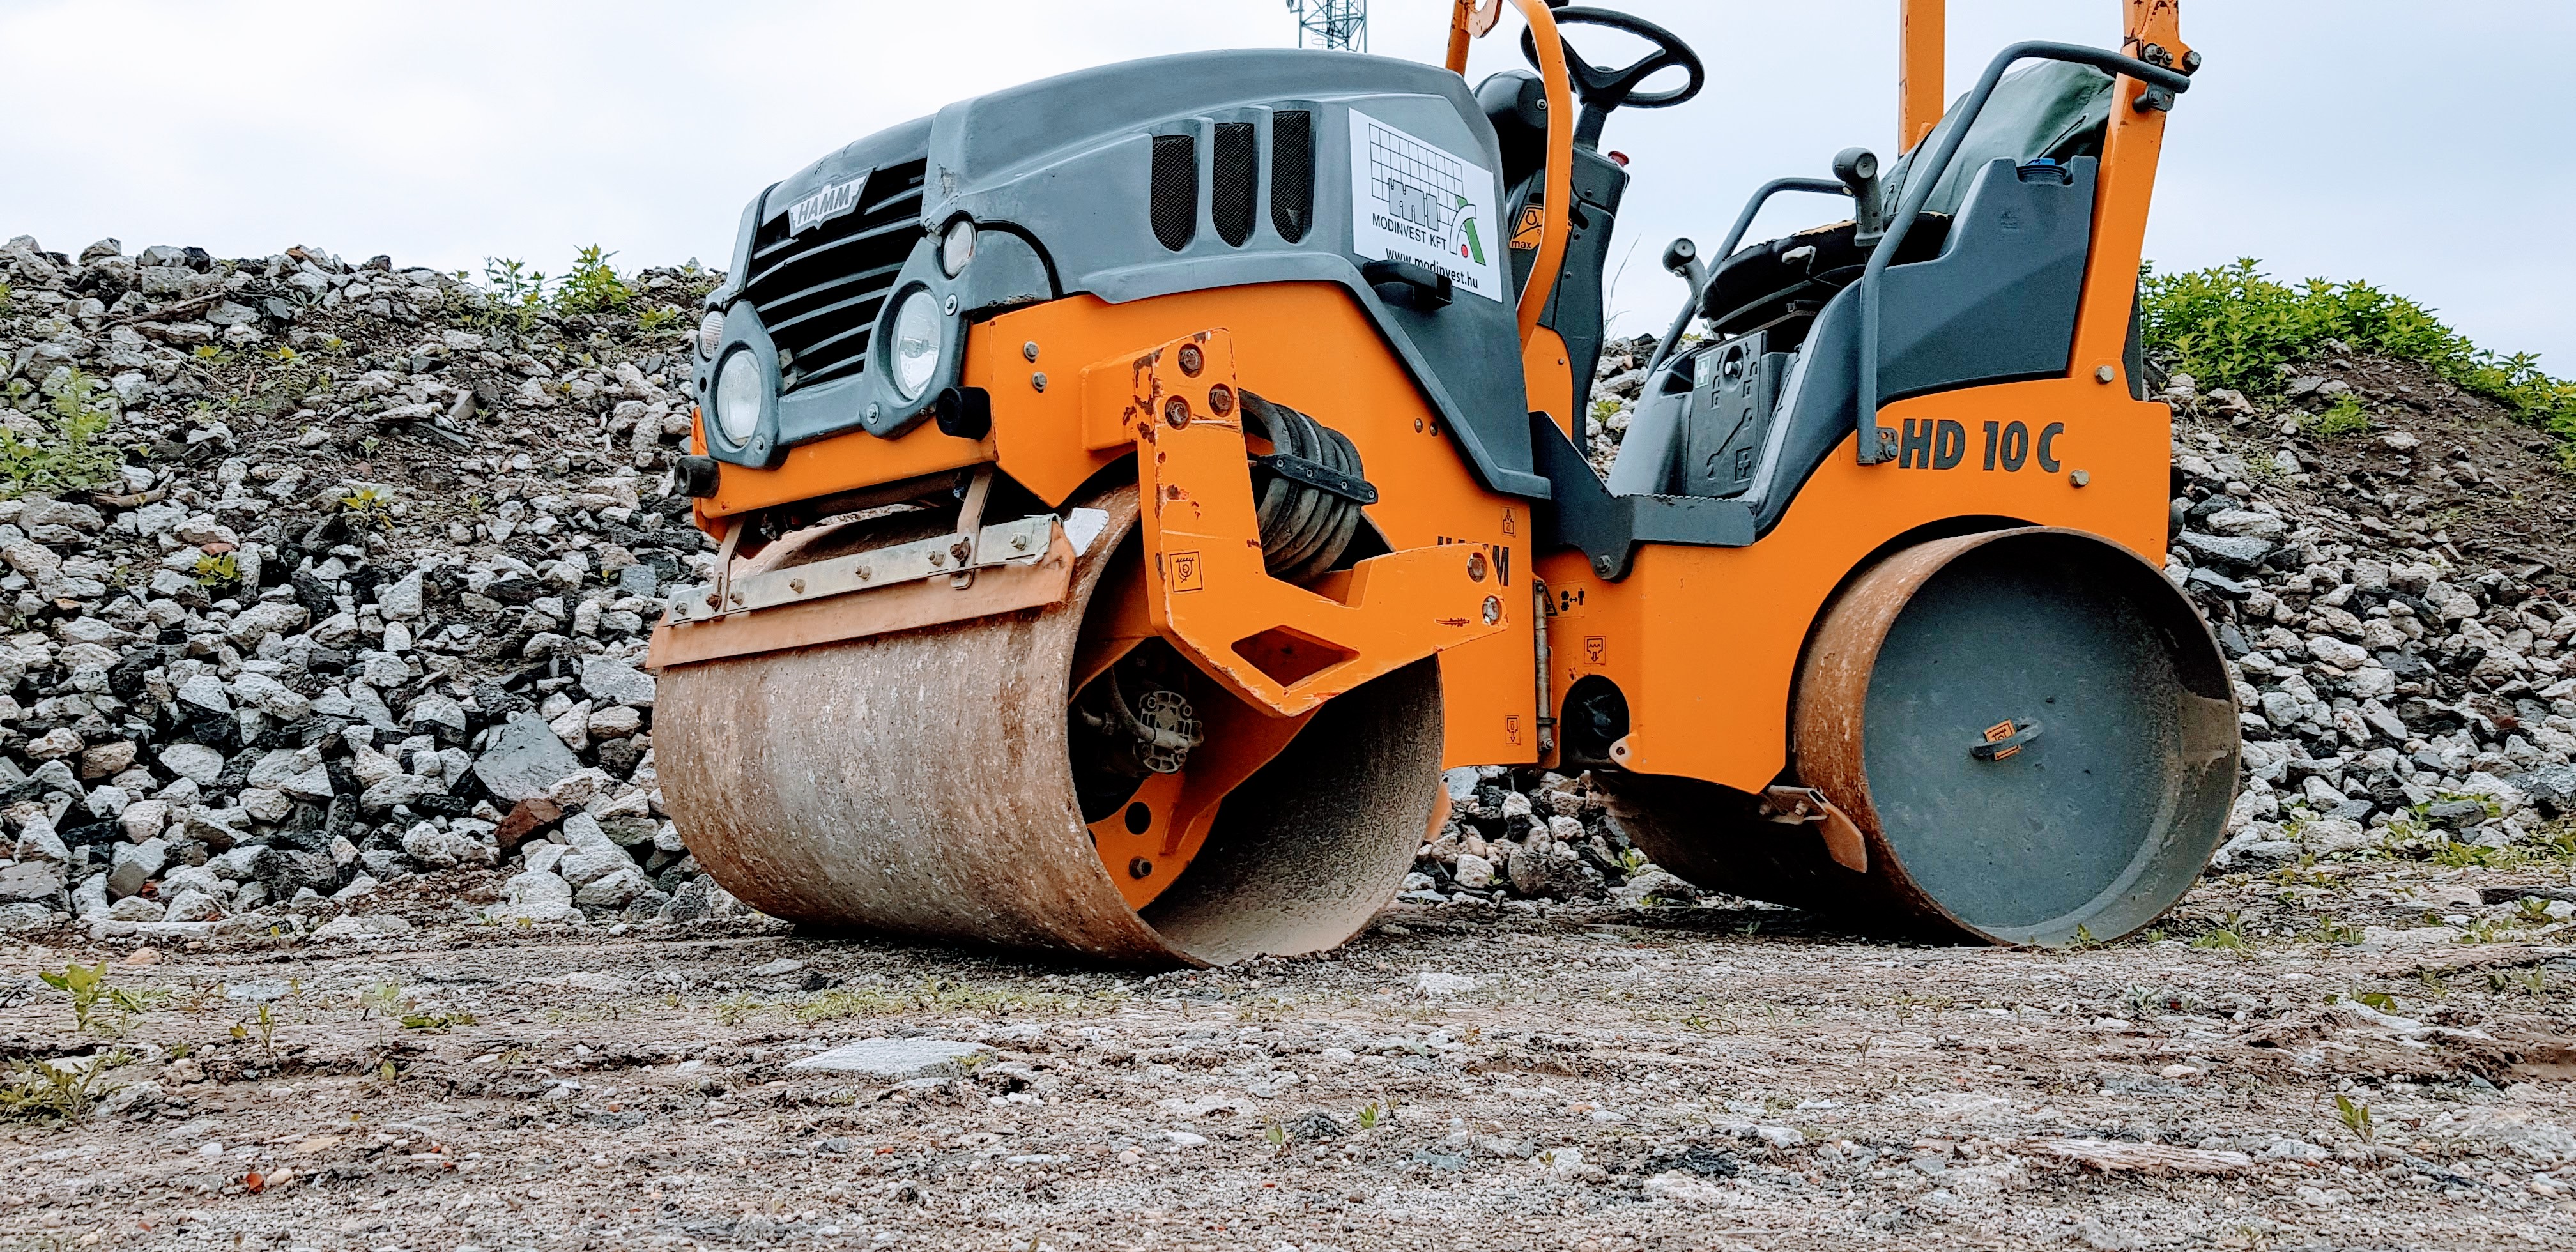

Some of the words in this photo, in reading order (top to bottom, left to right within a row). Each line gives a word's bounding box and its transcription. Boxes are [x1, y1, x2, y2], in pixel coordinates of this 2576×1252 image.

[797, 183, 851, 225] HAMM
[1372, 213, 1427, 244] MODINVEST
[1430, 234, 1447, 251] KFT
[1511, 240, 1532, 248] max
[1386, 248, 1478, 289] wwwmodinvest.hu
[1898, 418, 1966, 470] HD
[1982, 420, 2028, 473] 10
[2037, 422, 2064, 473] C
